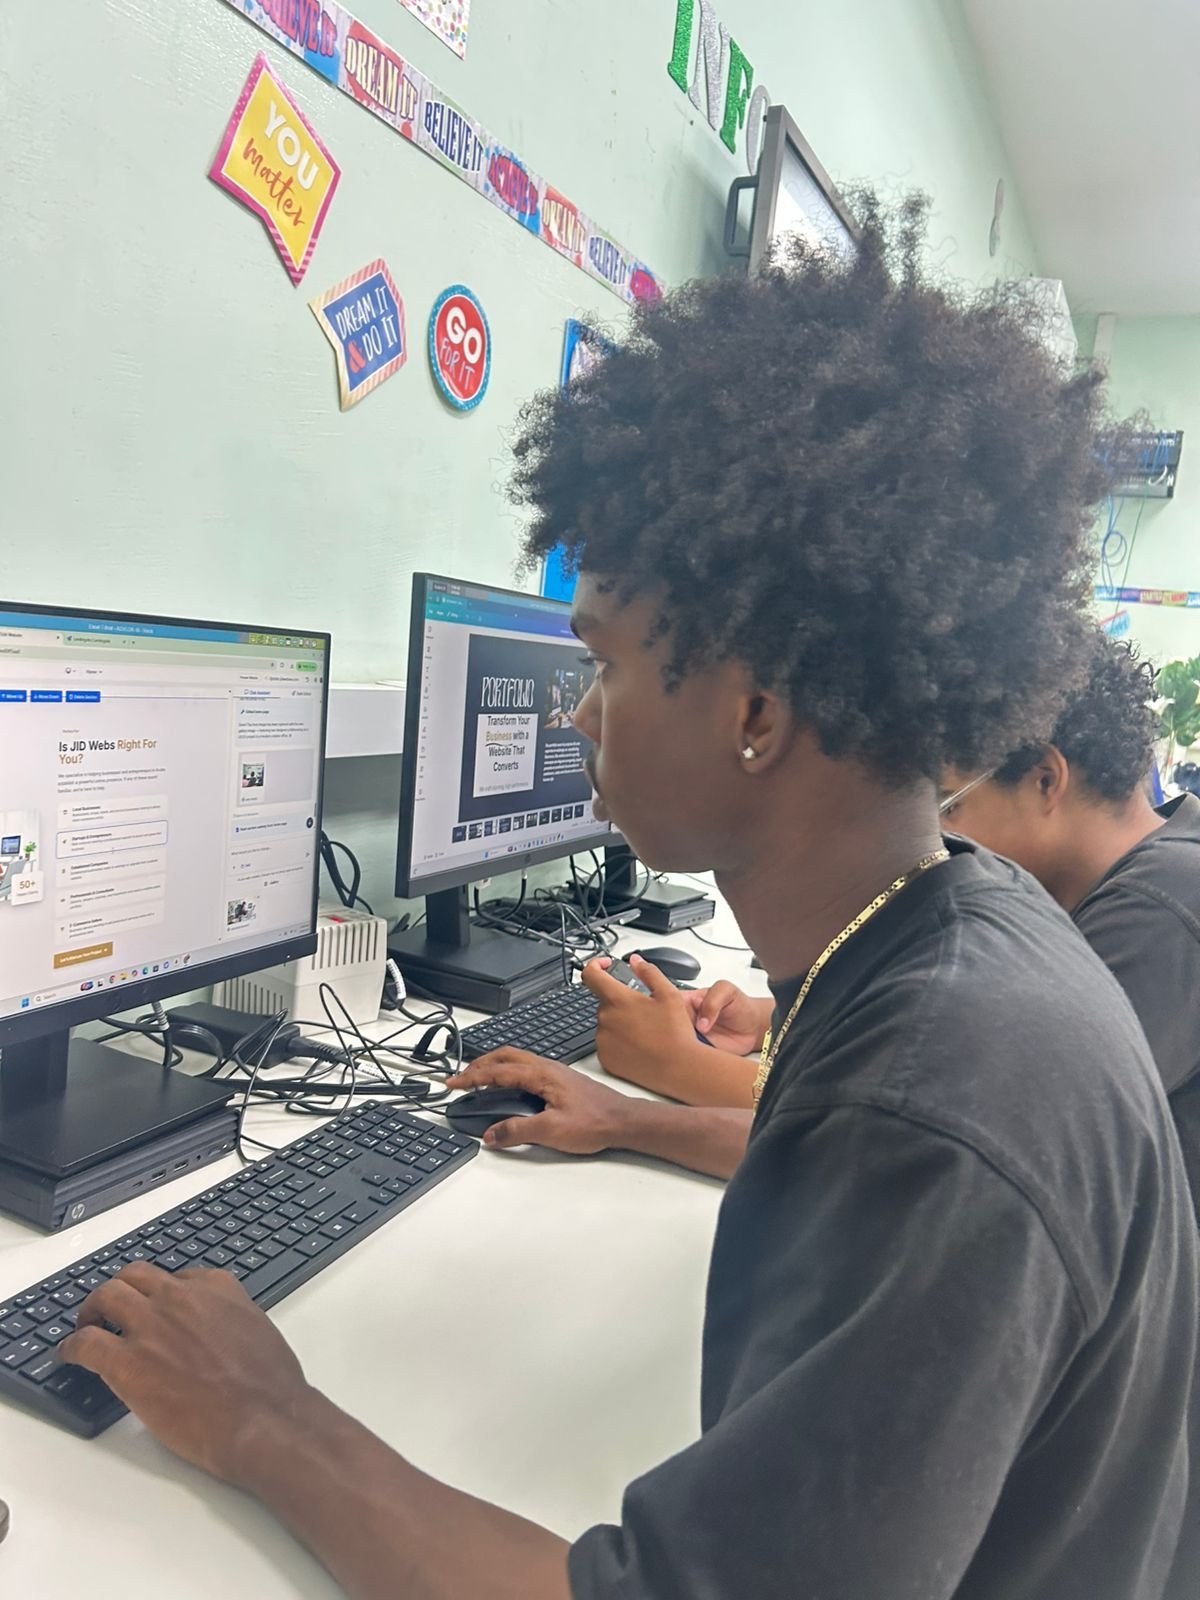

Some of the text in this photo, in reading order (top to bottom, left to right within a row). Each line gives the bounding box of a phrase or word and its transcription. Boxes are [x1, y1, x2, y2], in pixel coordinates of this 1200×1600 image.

[321, 10, 337, 57] IT
[345, 37, 418, 120] DREAM IT
[265, 101, 319, 190] YOU
[424, 101, 483, 171] BELIEVE IT
[243, 138, 305, 226] matter
[542, 198, 576, 250] DREAM
[589, 236, 619, 284] BELIEVE
[335, 286, 389, 341] DREAM IT
[446, 306, 482, 364] GO
[362, 325, 382, 361] DO
[382, 315, 398, 348] IT
[440, 337, 475, 390] FOR IT
[481, 676, 535, 708] PORTFOLIO
[486, 731, 512, 742] Business
[513, 731, 525, 739] with
[487, 715, 531, 726] Transform Your
[59, 739, 157, 752] Is JID Webs Right For
[59, 753, 84, 764] You?
[488, 745, 525, 757] Website That
[493, 761, 519, 772] Converts
[19, 880, 36, 889] 50+
[49, 1326, 61, 1334] Q
